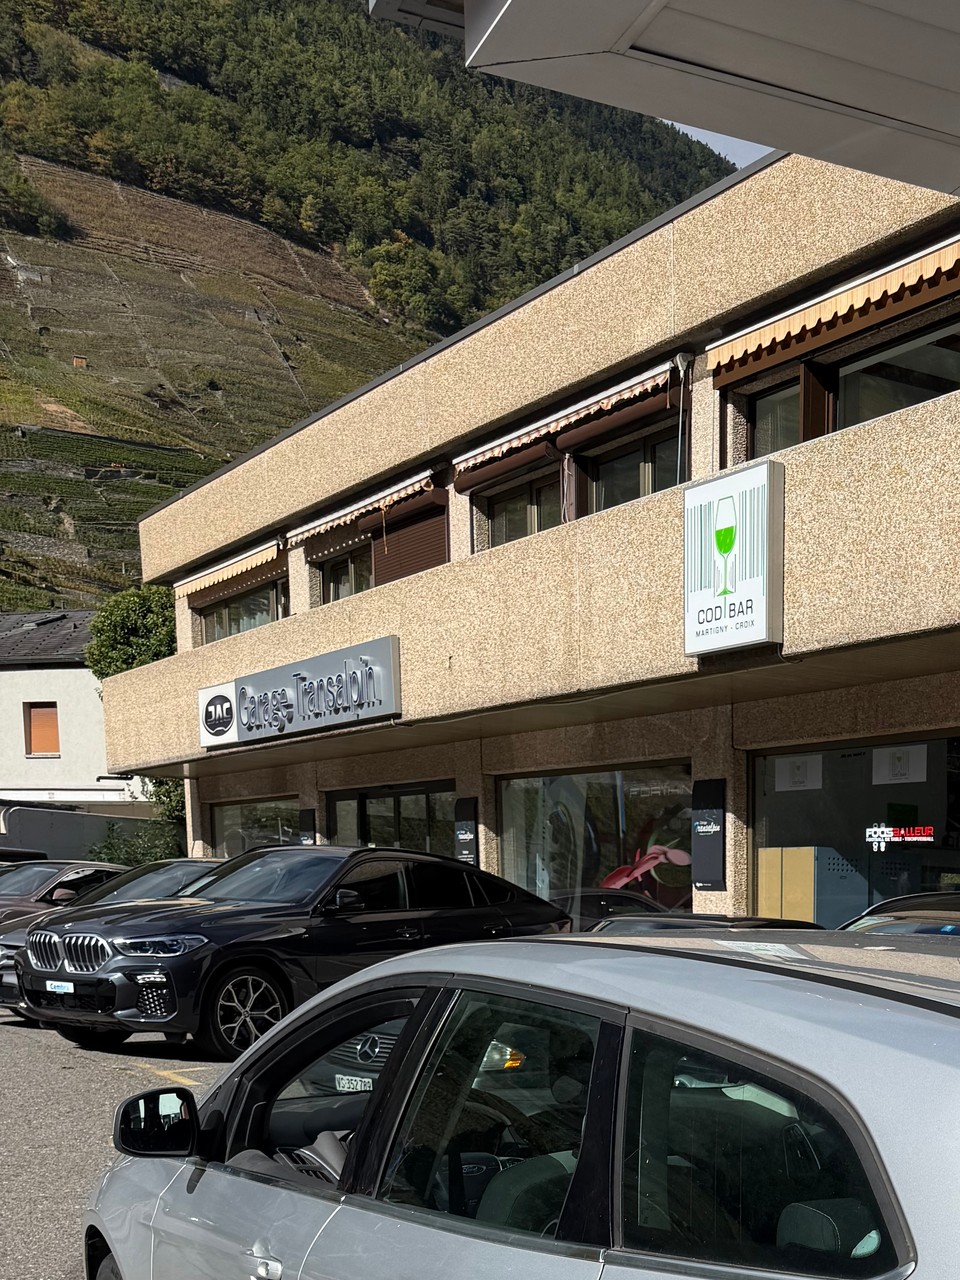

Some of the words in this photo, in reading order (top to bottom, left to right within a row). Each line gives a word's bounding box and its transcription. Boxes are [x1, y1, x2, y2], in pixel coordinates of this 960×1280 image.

[695, 625, 729, 638] MARTIGNY
[734, 619, 756, 630] CROIX
[238, 685, 291, 730] Garage
[292, 656, 378, 716] Transalpin
[207, 701, 231, 722] JAC
